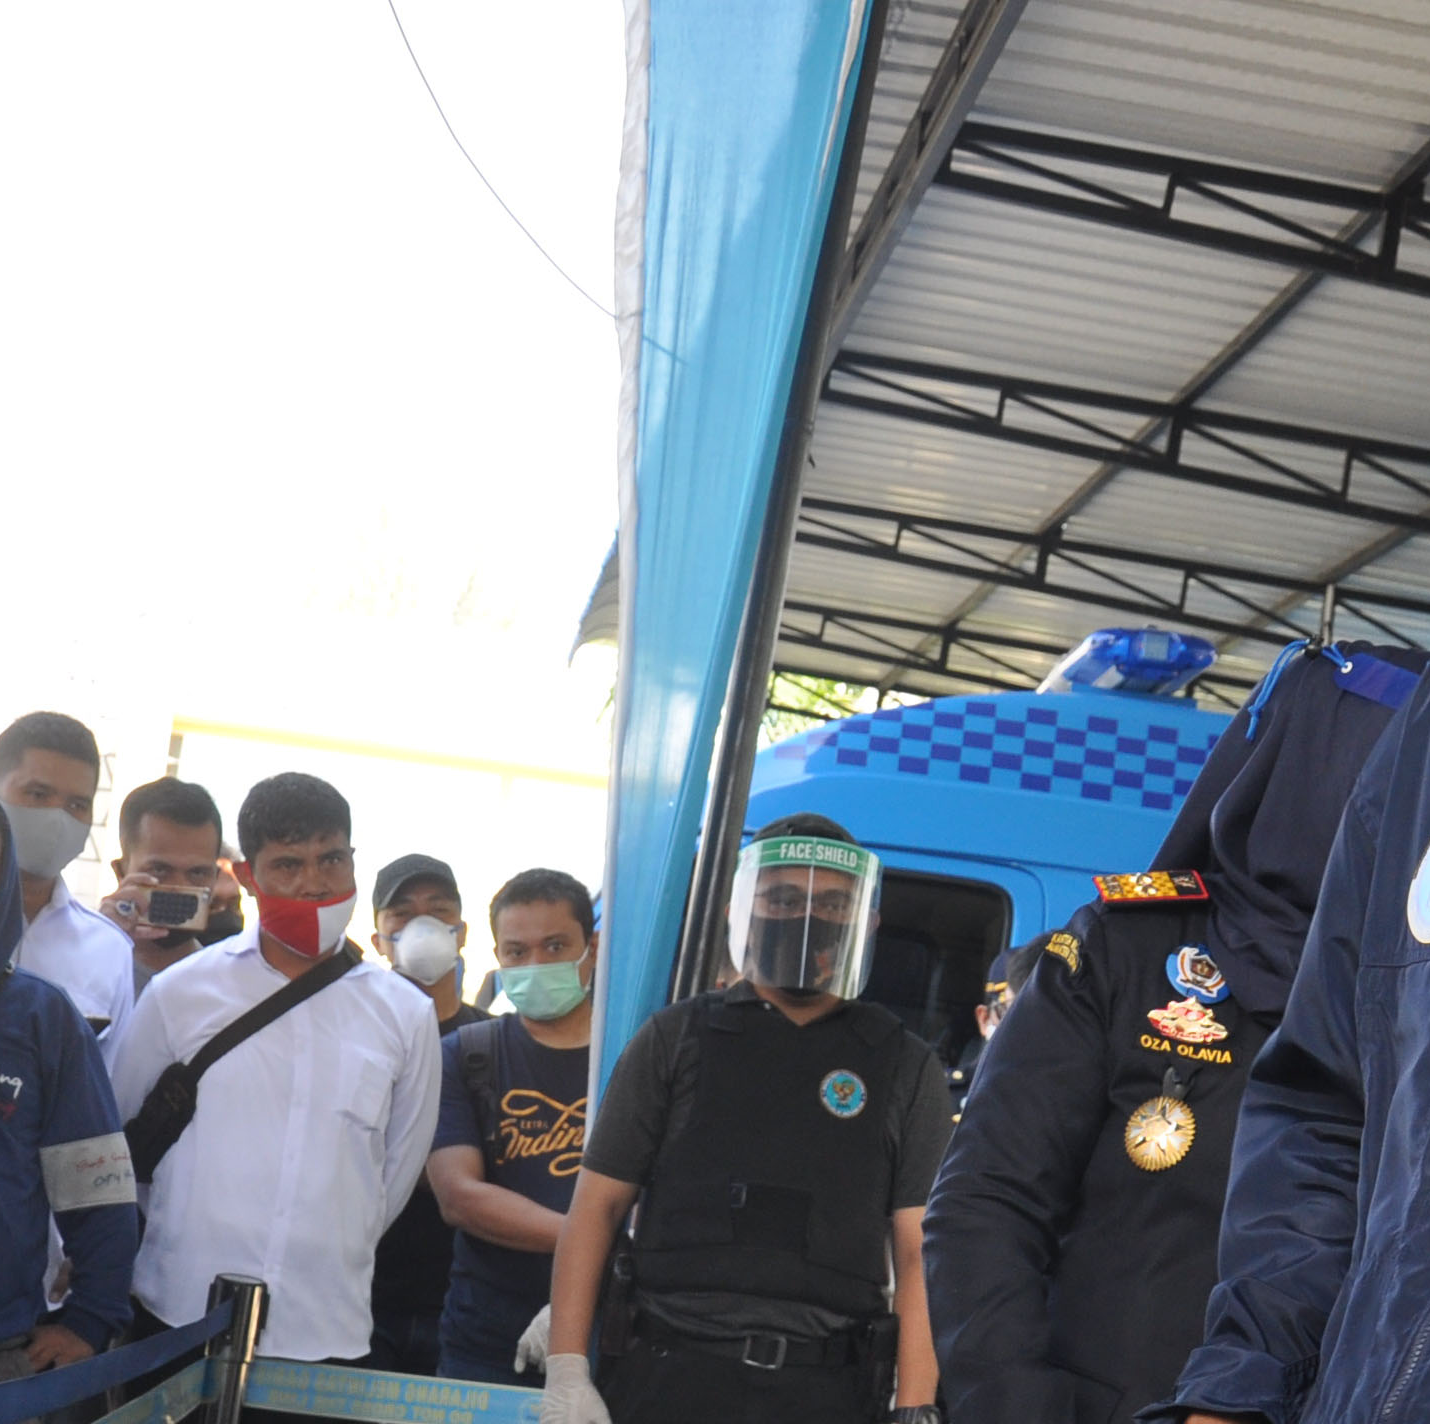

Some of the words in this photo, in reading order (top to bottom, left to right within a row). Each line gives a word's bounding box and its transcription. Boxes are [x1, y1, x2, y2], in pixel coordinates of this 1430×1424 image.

[779, 842, 813, 860] FACE
[815, 844, 859, 868] SHIELD
[1140, 1033, 1172, 1053] OZA
[1176, 1044, 1233, 1064] OLAVIA
